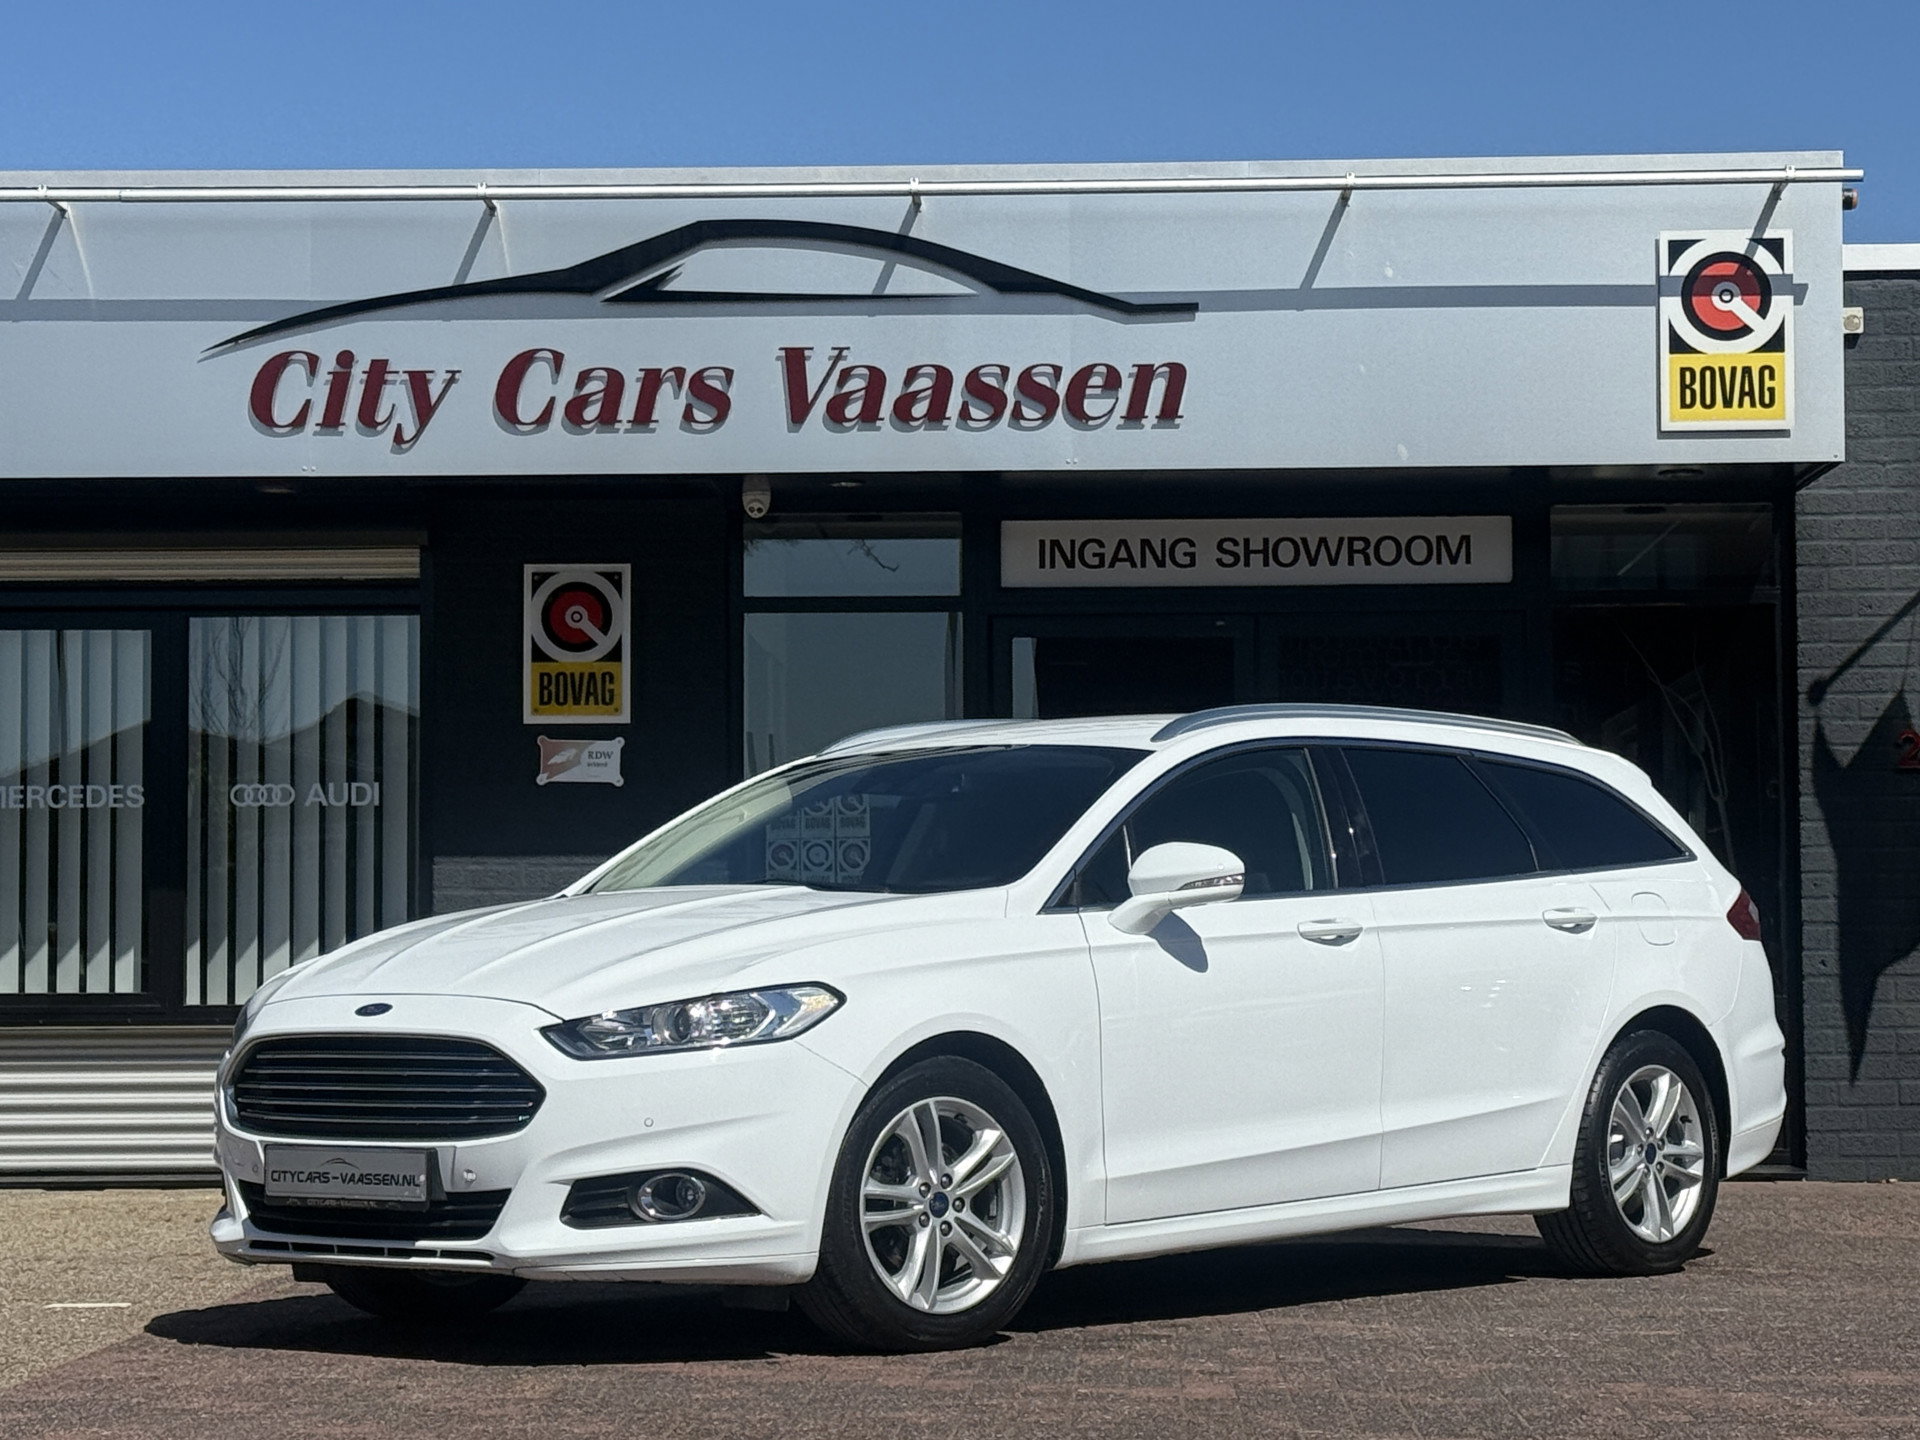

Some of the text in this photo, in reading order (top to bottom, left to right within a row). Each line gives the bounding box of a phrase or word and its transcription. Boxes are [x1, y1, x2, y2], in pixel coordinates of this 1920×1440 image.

[249, 346, 1189, 446] City Cars Vaassen
[1679, 364, 1776, 410] BOVAG
[1037, 534, 1473, 570] INGANG SHOWROOM
[538, 670, 615, 707] BOVAG
[588, 751, 614, 760] RDW
[304, 781, 380, 807] AUDI
[270, 1169, 421, 1187] CITYCARS-VAASSEN.NL
